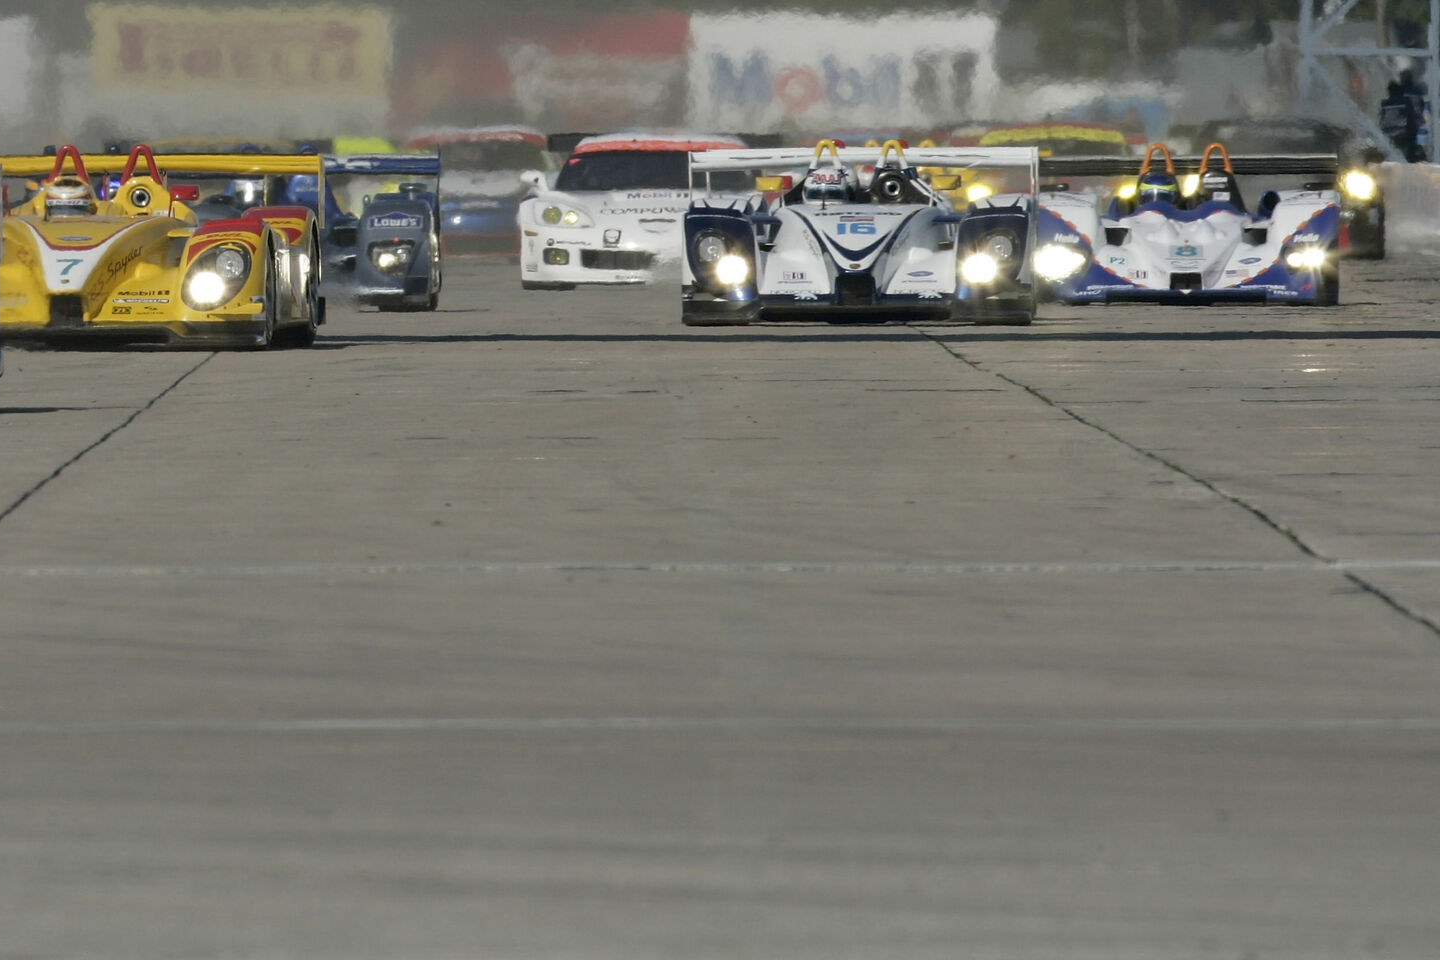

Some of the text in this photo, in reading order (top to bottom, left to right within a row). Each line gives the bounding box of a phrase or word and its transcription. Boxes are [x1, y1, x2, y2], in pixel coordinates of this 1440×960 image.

[836, 222, 877, 235] 16
[1175, 244, 1198, 258] 8
[56, 259, 84, 276] 7
[107, 246, 144, 279] Spyder
[1109, 256, 1126, 266] P2
